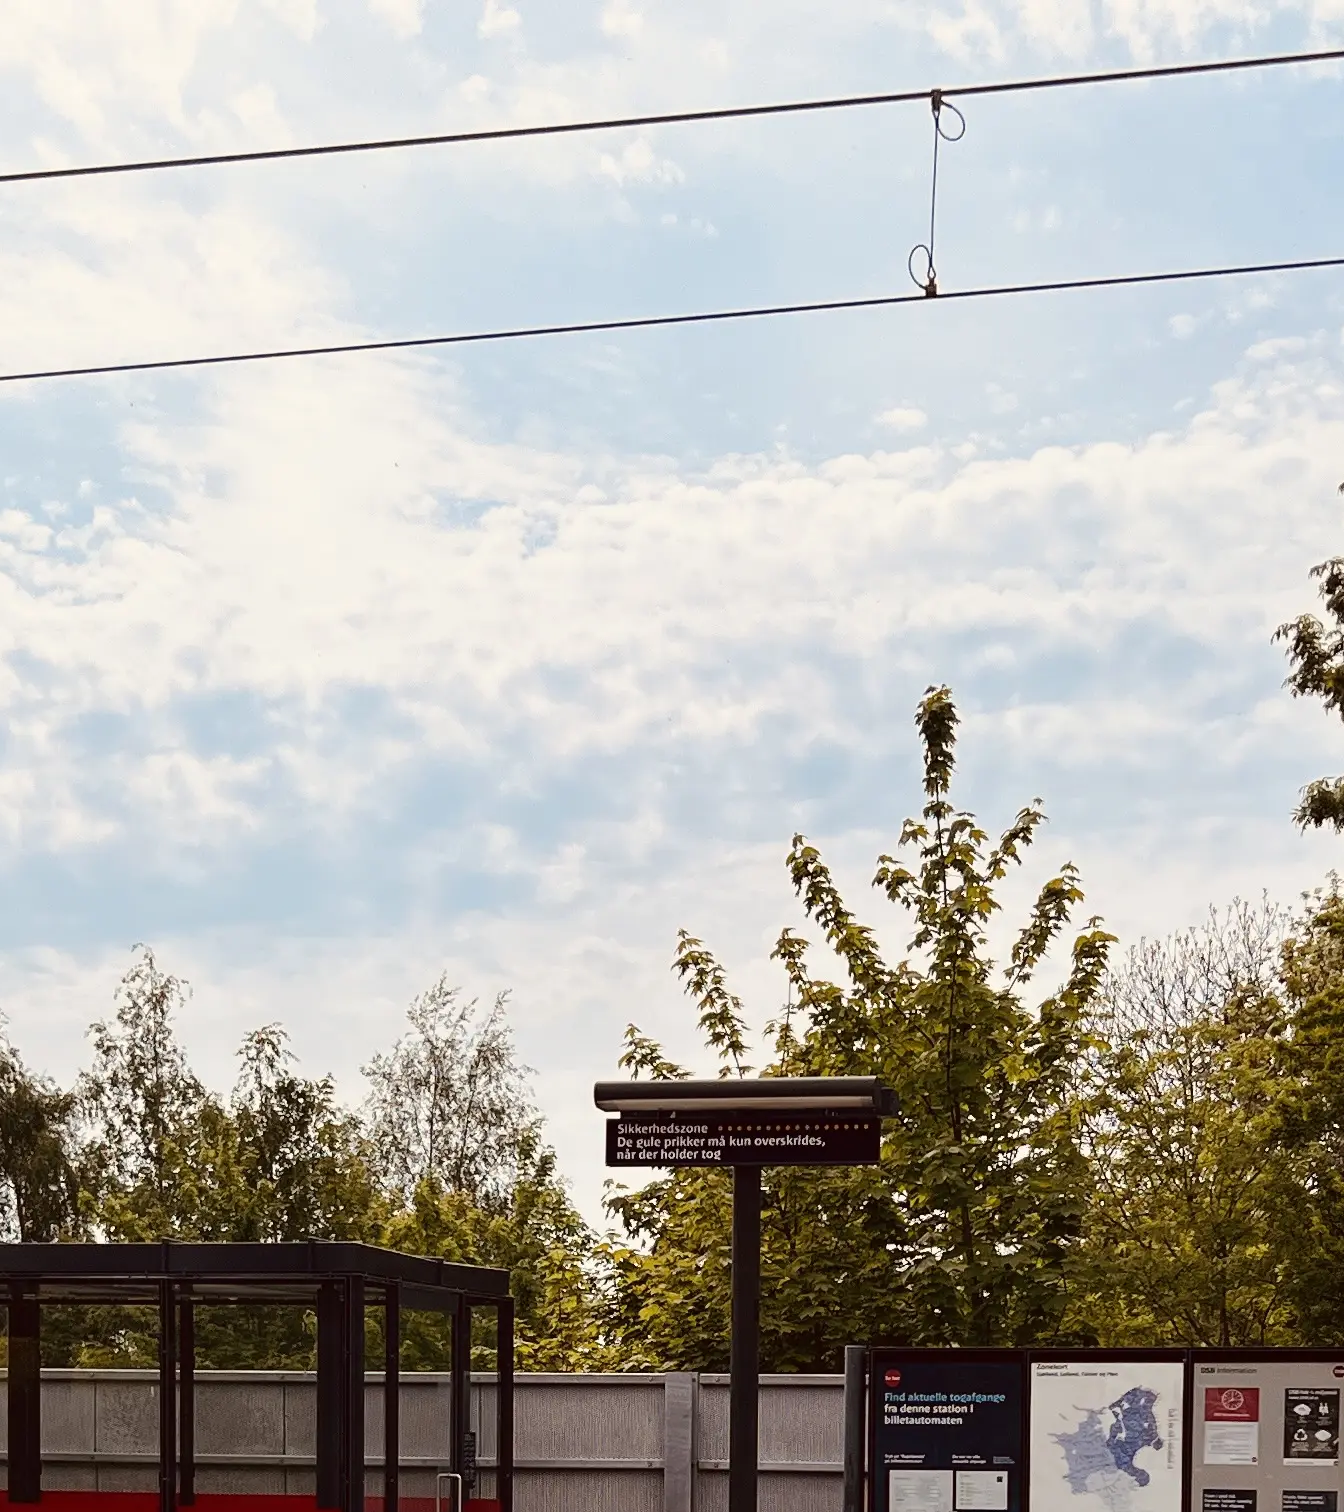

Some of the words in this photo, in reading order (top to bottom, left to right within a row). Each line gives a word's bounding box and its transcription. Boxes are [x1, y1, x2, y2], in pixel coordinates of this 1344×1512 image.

[617, 1122, 709, 1134] Sikkerhedszone
[617, 1136, 633, 1147] De
[636, 1136, 661, 1149] gule
[664, 1135, 705, 1149] prikker
[707, 1134, 726, 1147] må
[729, 1135, 752, 1147] kun
[754, 1134, 826, 1147] overskrides,
[616, 1148, 637, 1160] når
[638, 1149, 659, 1160] der
[660, 1148, 699, 1160] holder
[701, 1149, 722, 1161] tog
[884, 1392, 906, 1402] Find
[907, 1392, 948, 1402] aktuelle
[949, 1393, 1006, 1404] togafgange
[884, 1404, 898, 1413] fra
[900, 1404, 931, 1413] denne
[932, 1404, 968, 1413] station
[884, 1415, 963, 1425] billetautomaten
